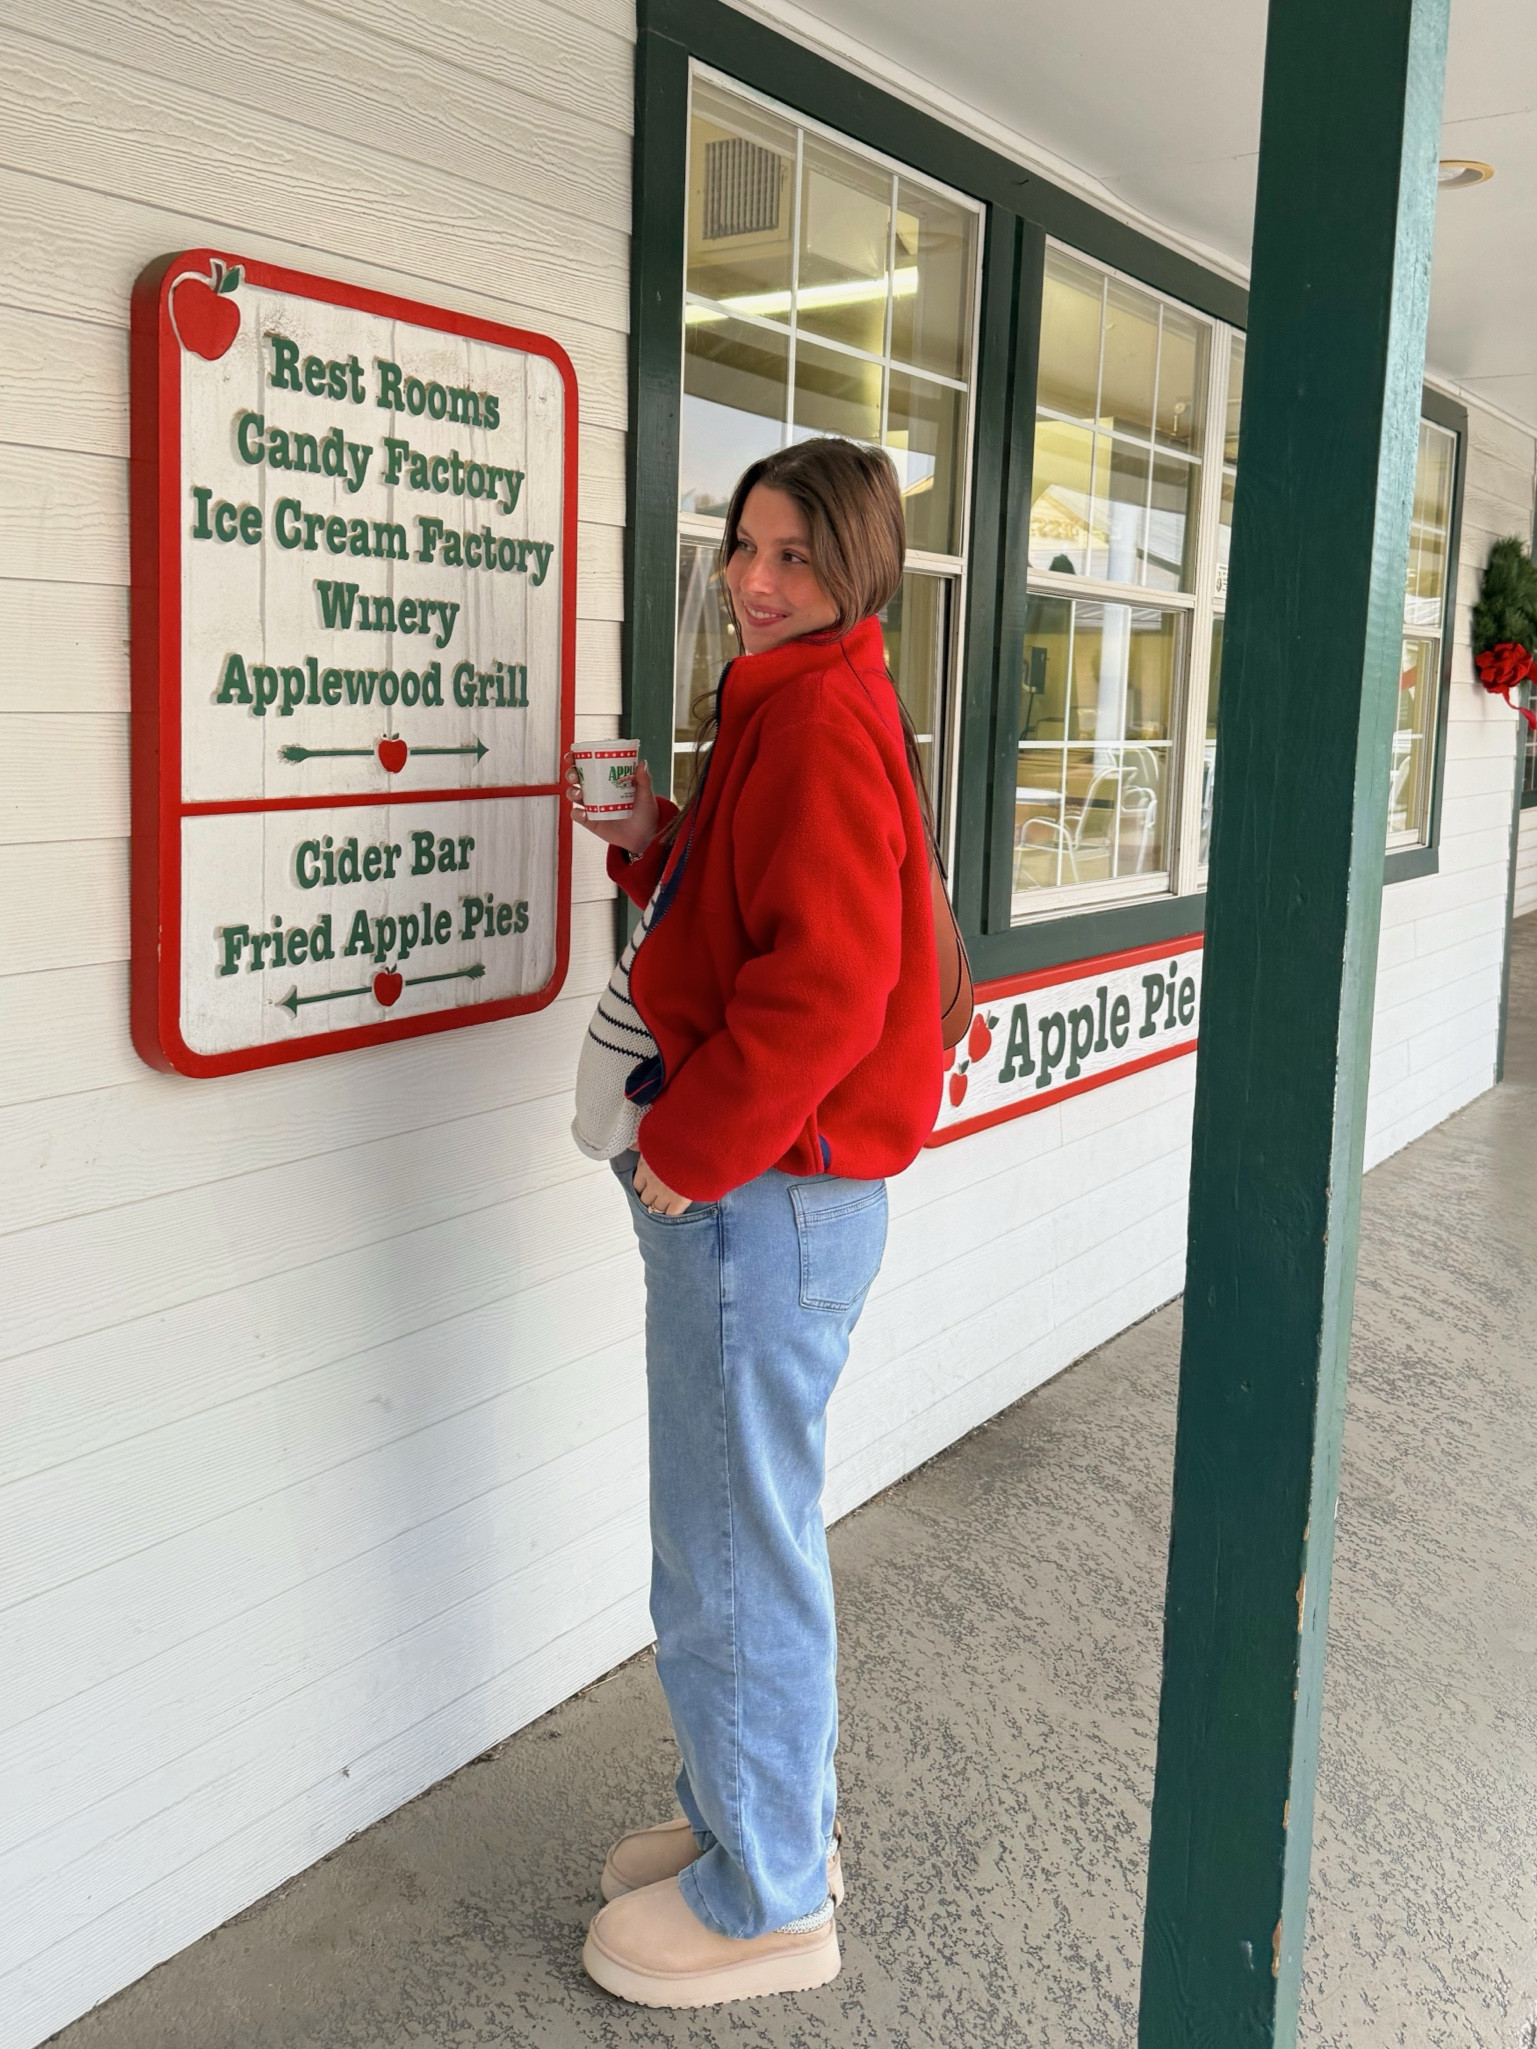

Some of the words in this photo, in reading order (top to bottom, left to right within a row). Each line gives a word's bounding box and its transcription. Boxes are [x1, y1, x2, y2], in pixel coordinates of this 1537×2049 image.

[271, 337, 366, 404] Rest
[376, 361, 500, 430] Rooms
[237, 413, 373, 493] Candy
[383, 437, 525, 514] Factory
[192, 487, 262, 544] Ice
[275, 499, 409, 561] Cream
[418, 517, 554, 586] Factory
[316, 580, 460, 649] Winery
[216, 653, 444, 717] Applewood
[453, 661, 529, 708] Grill
[296, 836, 402, 889] Cider
[411, 831, 475, 876] Bar
[219, 914, 335, 977] Fried
[344, 903, 452, 963] Apple
[460, 894, 530, 940] Pies
[998, 1002, 1131, 1089] Apple
[1138, 960, 1197, 1039] Pie
